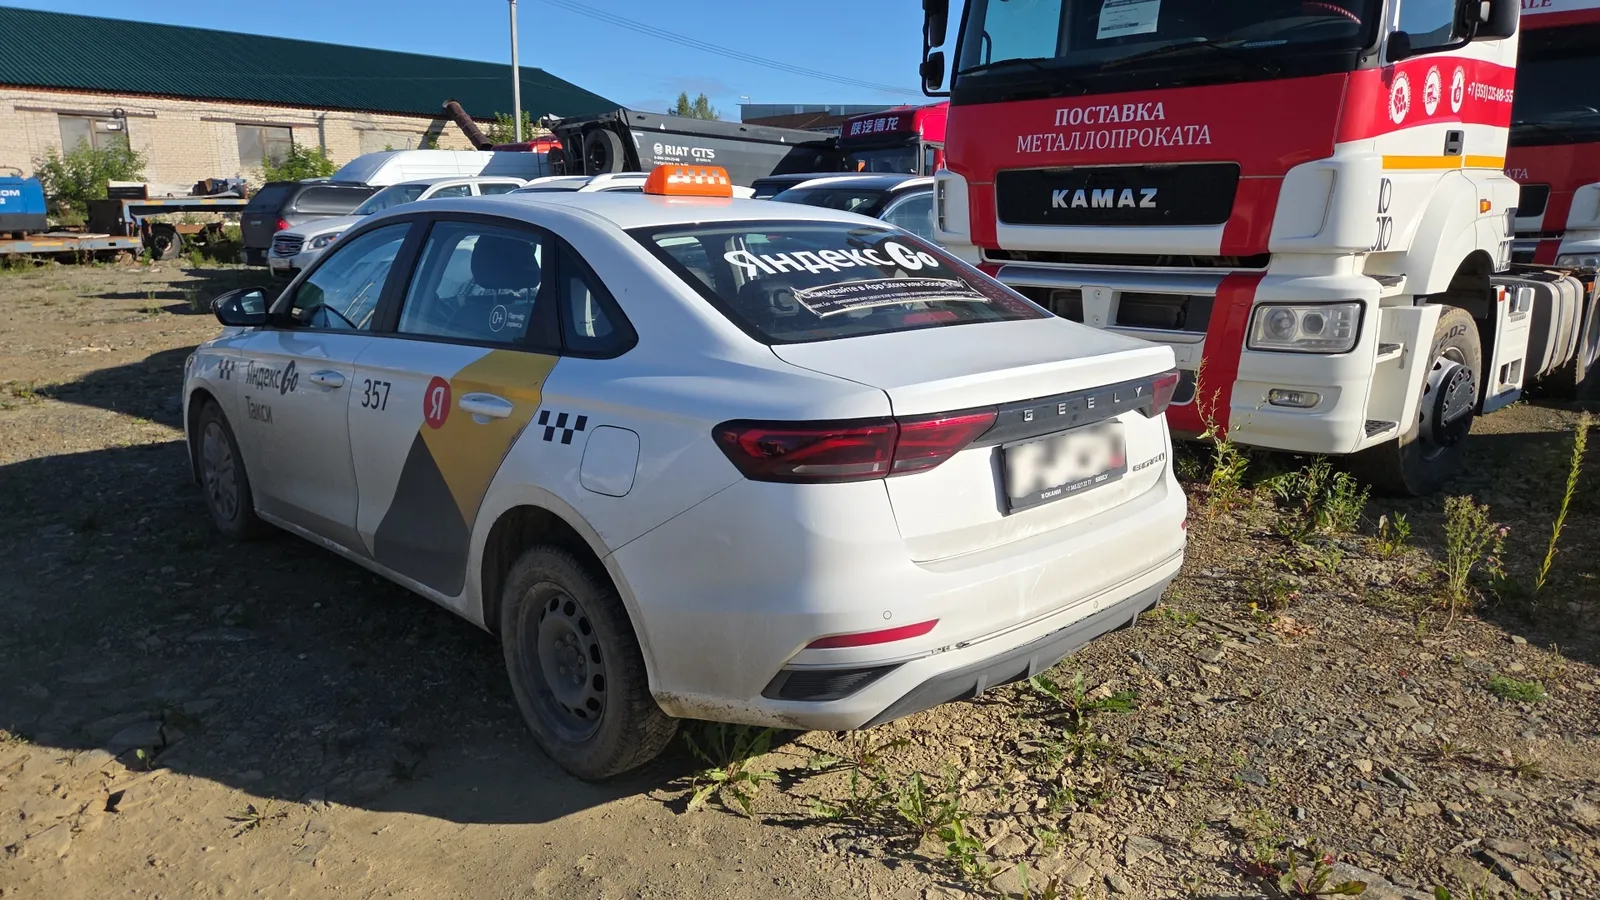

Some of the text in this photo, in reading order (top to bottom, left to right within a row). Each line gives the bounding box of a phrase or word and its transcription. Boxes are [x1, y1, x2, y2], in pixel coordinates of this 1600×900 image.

[1467, 82, 1475, 96] +7
[1054, 102, 1165, 126] ПОСТАВКА
[664, 144, 689, 157] RIAT
[691, 147, 715, 159] GTS
[1016, 124, 1212, 153] МЕТАЛЛОПРОКАТА
[1052, 188, 1158, 208] KAMAZ
[723, 241, 940, 278] Яндекс Go
[801, 284, 860, 299] Скачивайте
[865, 282, 885, 291] App
[246, 360, 299, 395] Яндекс Go
[361, 378, 391, 411] 357
[429, 386, 445, 420] Я
[1023, 386, 1142, 422] GEELY
[245, 395, 273, 424] Такси
